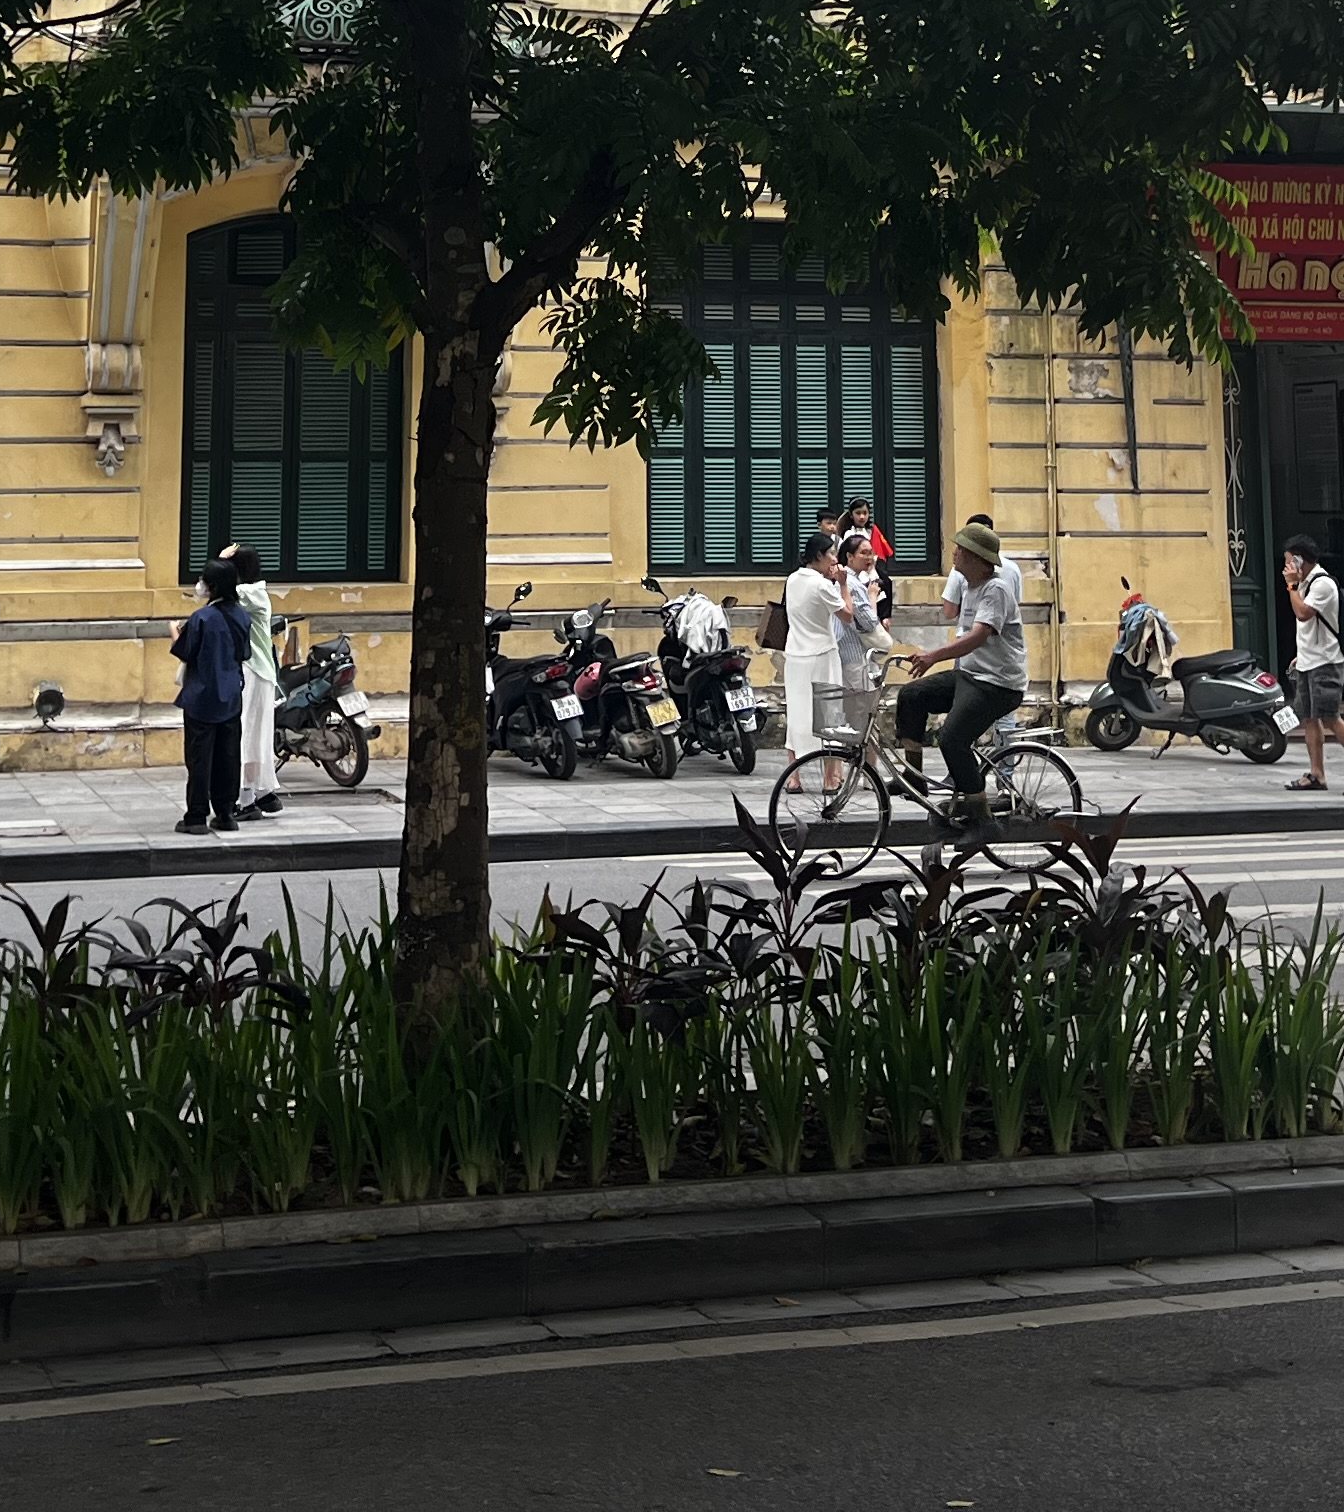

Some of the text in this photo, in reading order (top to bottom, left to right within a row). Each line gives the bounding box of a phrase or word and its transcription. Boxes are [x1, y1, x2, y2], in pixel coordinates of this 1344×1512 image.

[1272, 176, 1311, 204] MỪNG
[1314, 175, 1332, 205] KỶ
[1261, 213, 1278, 239] XÃ
[1283, 213, 1304, 244] HỘI
[1308, 211, 1333, 241] CHỦ
